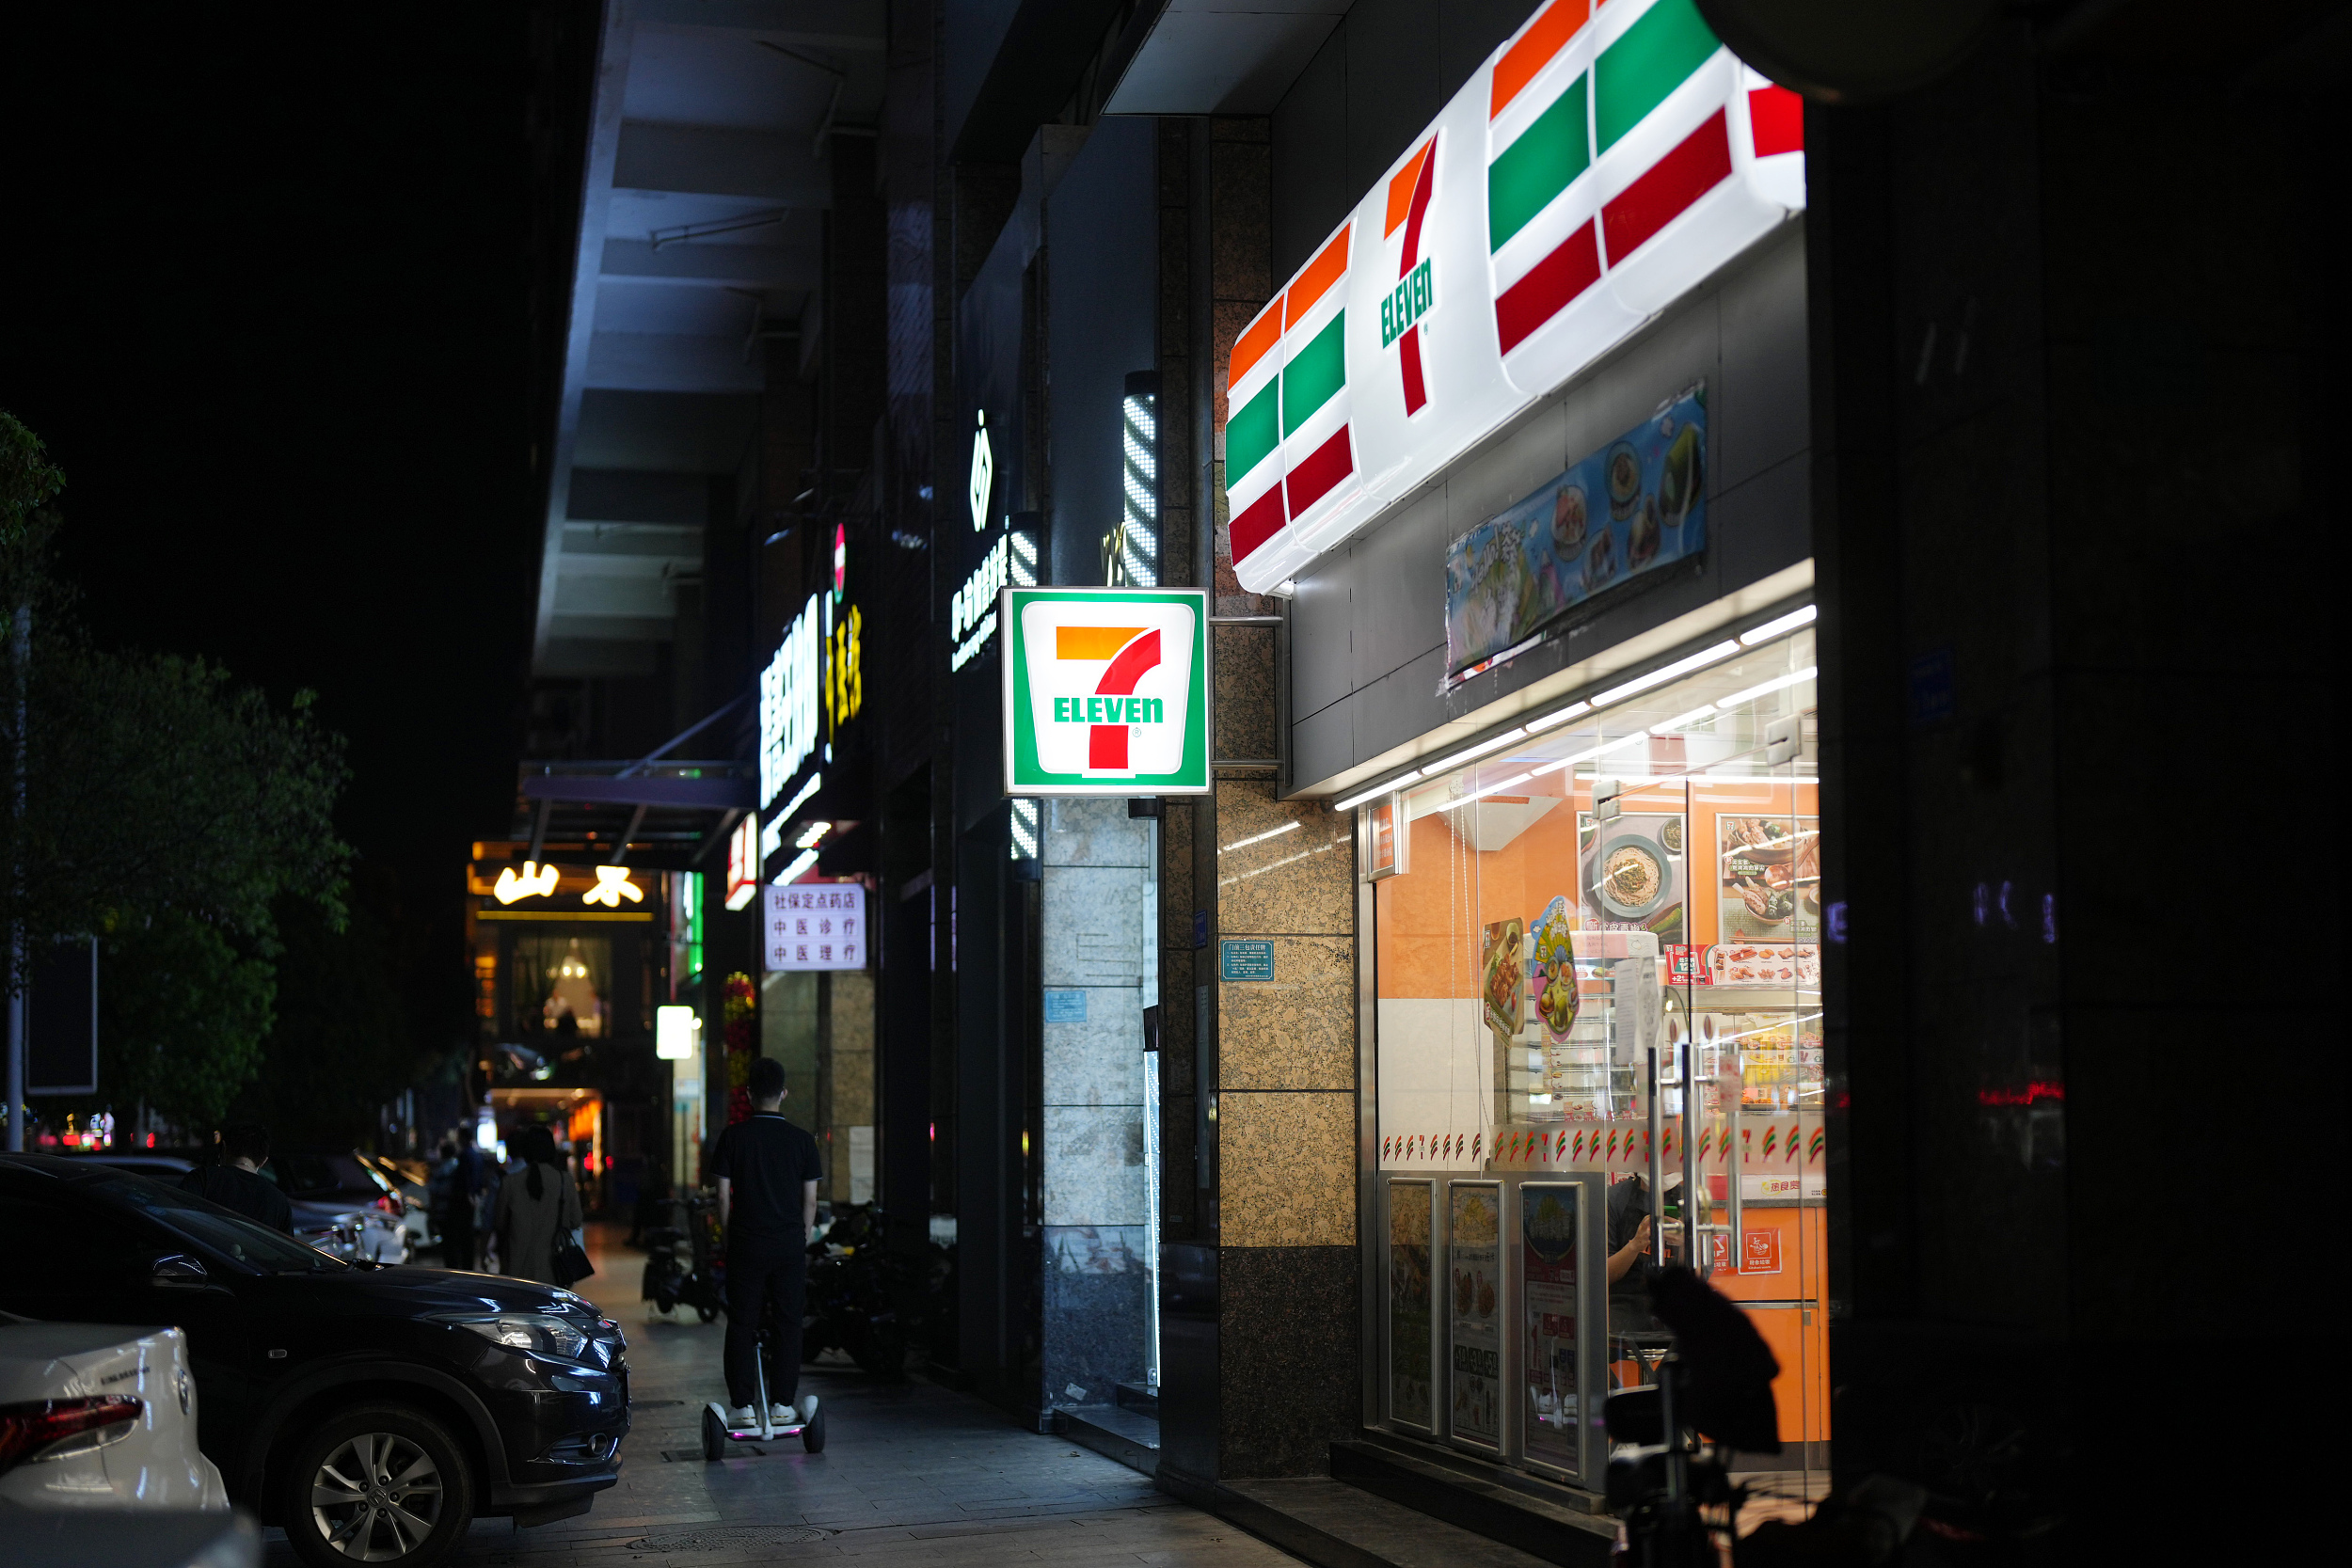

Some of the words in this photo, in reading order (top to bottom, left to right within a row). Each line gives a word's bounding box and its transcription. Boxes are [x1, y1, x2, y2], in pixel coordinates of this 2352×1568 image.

[1056, 626, 1161, 769] 7
[773, 891, 855, 910] 社保定点药店
[773, 917, 855, 936] 中医诊疗
[773, 943, 855, 962] 中医理疗
